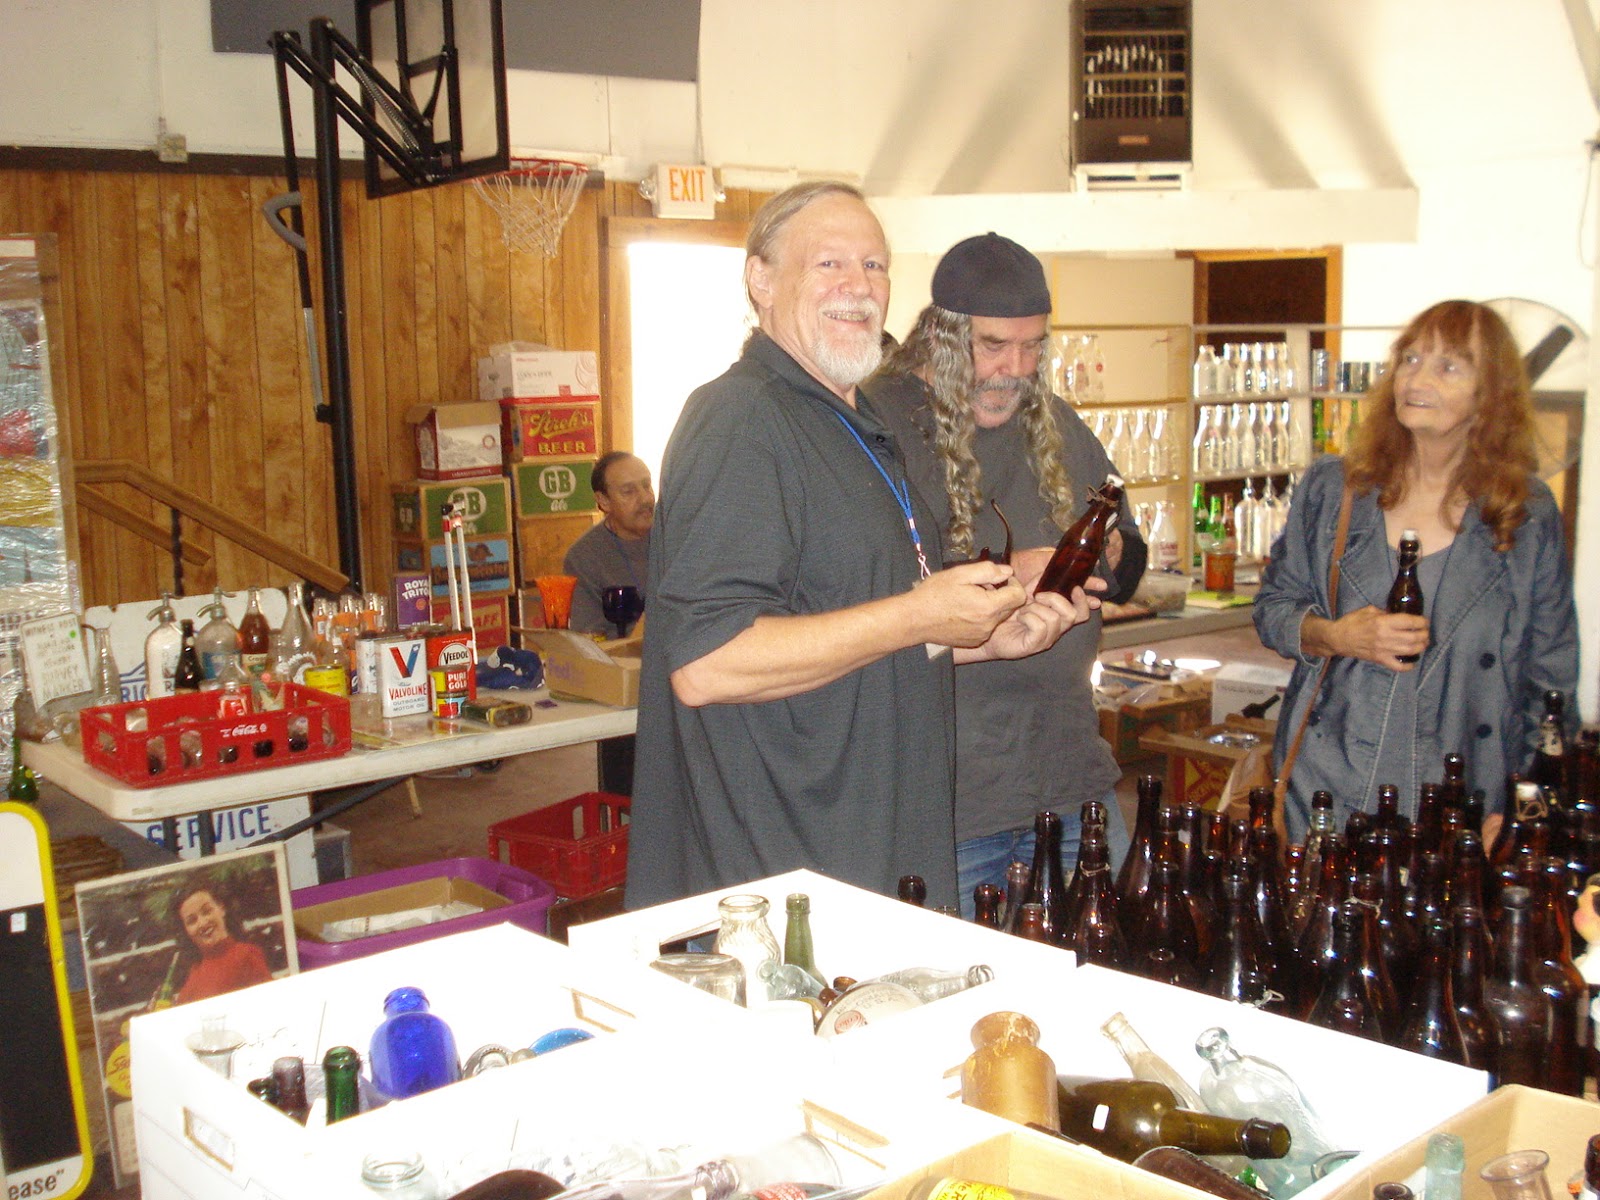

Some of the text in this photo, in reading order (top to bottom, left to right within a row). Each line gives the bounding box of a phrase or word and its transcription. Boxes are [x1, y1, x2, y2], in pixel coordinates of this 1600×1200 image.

[668, 166, 706, 202] EXIT
[538, 440, 587, 454] BEER
[544, 470, 571, 493] GB
[443, 650, 469, 665] VEEDOL
[388, 682, 428, 700] VALVOLINE
[393, 704, 415, 712] MOTOR
